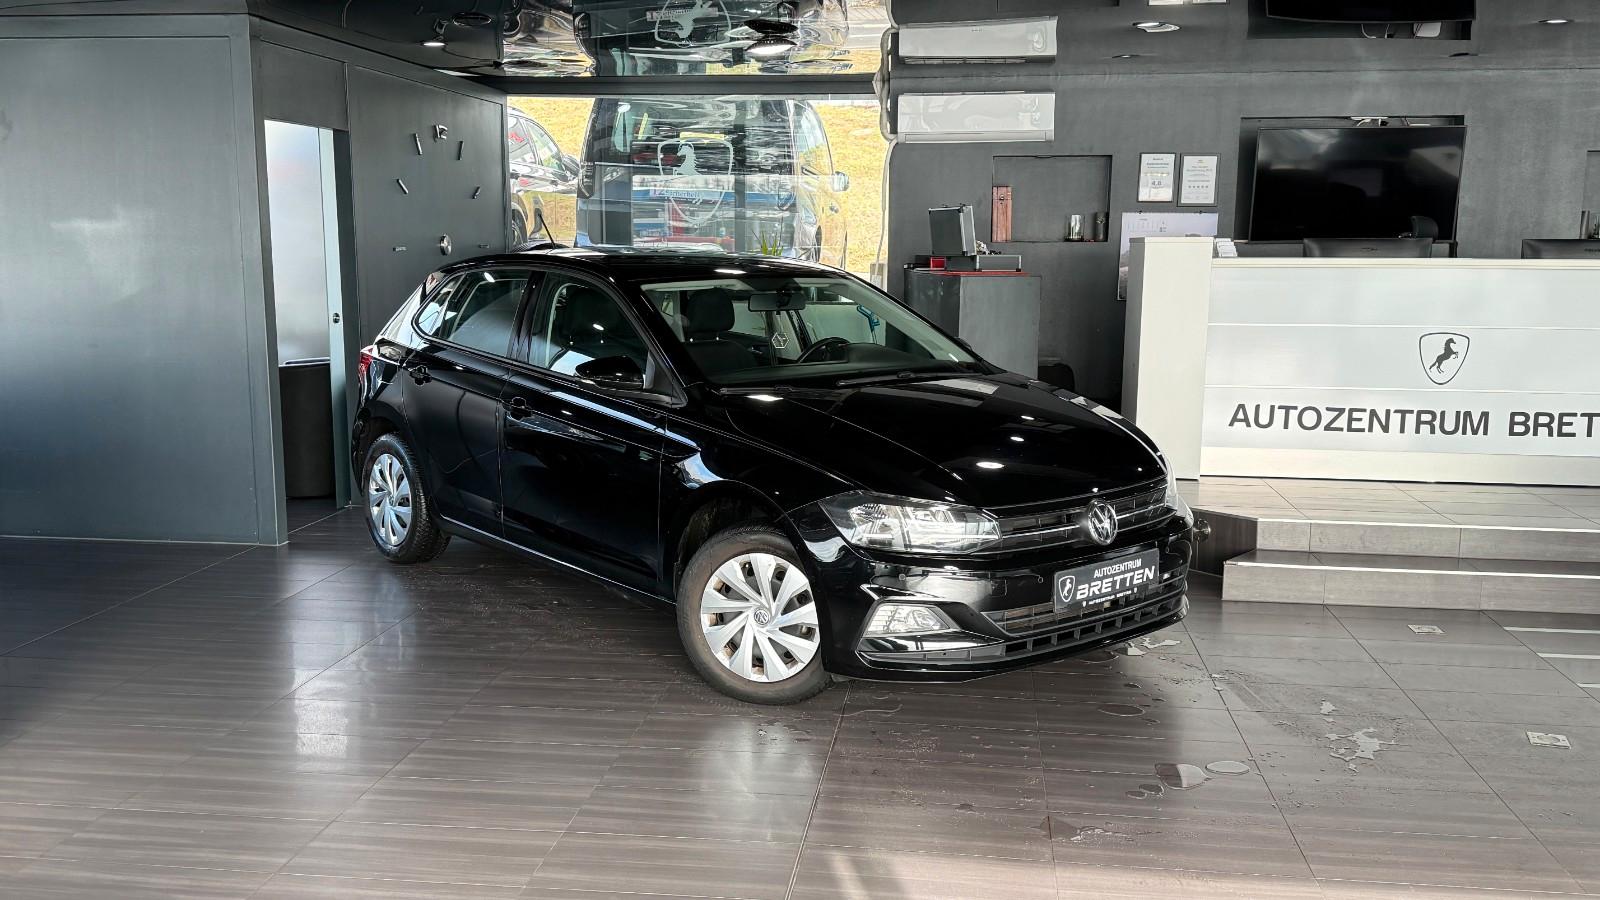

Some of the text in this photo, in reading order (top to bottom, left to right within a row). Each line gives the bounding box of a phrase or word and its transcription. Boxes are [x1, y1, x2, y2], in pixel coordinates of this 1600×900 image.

[1228, 403, 1600, 437] AUTOZENTRUM BRET
[1076, 565, 1155, 600] BRETTEN
[1094, 559, 1142, 578] AUTOZENTRUM
